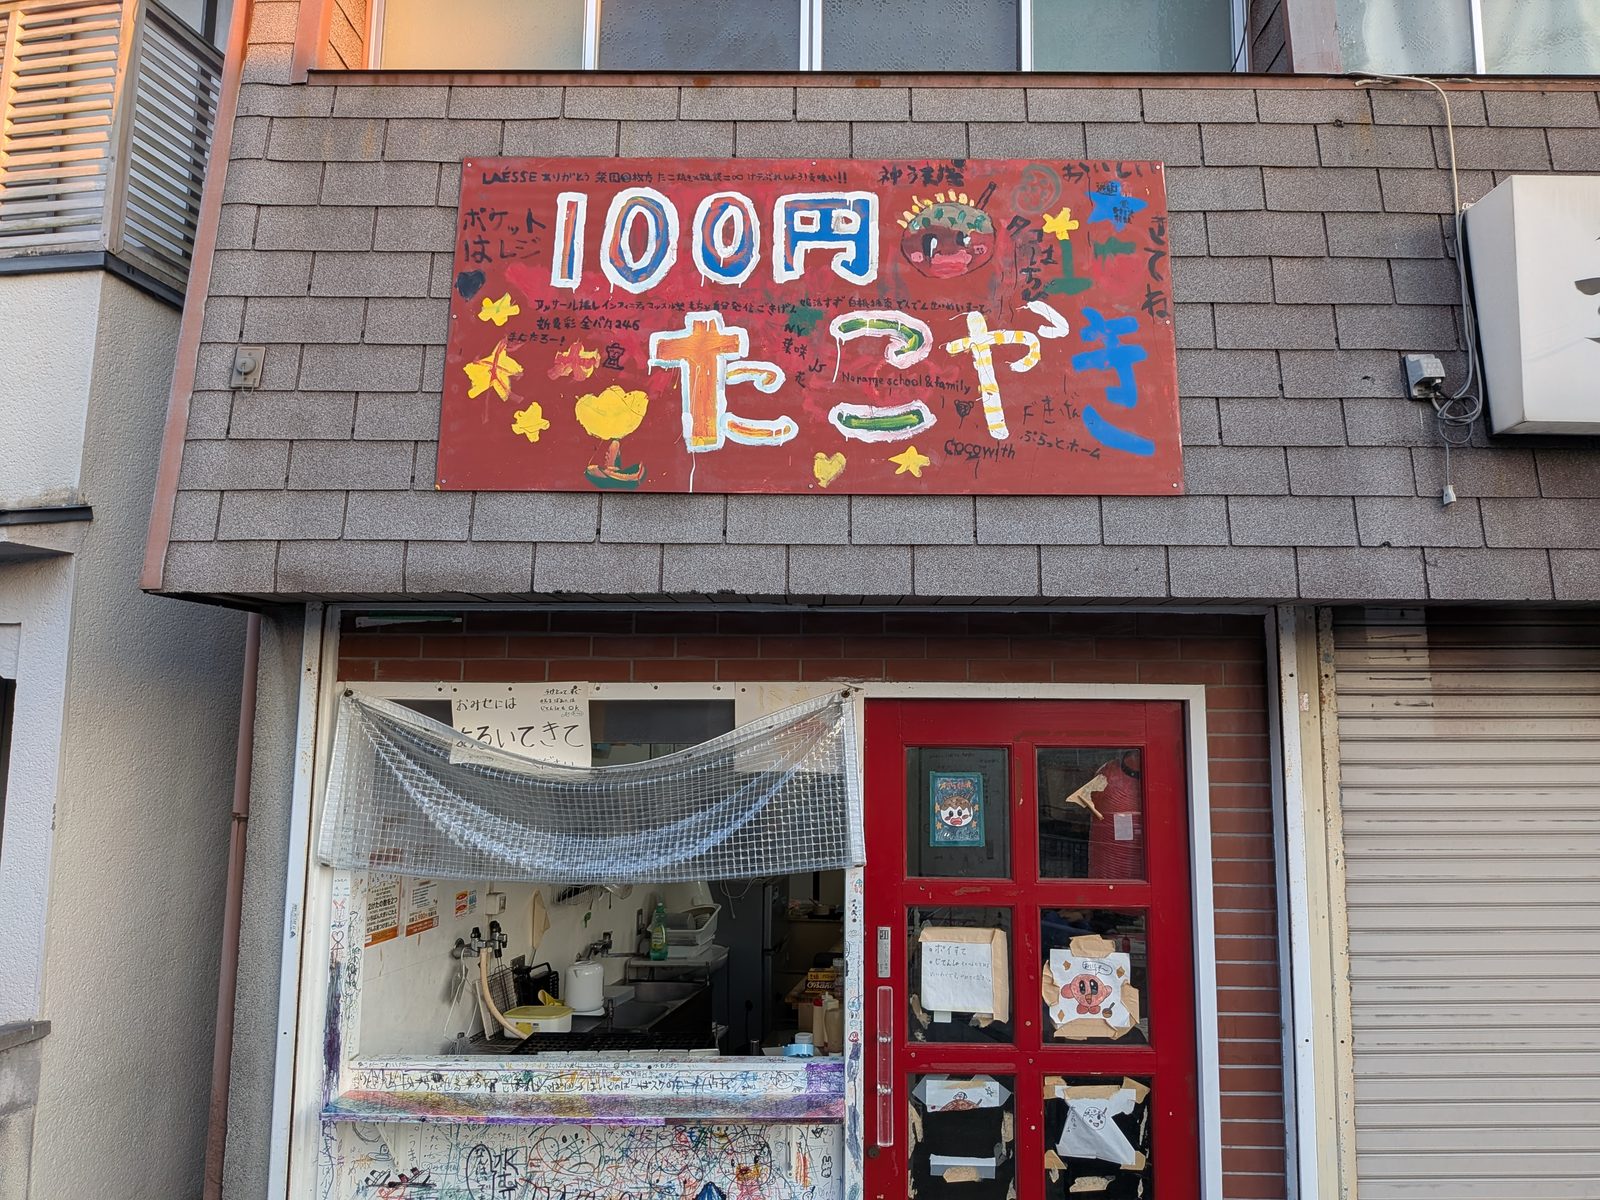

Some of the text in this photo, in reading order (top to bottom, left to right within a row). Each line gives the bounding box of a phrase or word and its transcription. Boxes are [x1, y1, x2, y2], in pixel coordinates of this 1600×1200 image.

[463, 207, 547, 235] ポケット
[551, 187, 879, 293] 100円
[648, 301, 1156, 457] たこやき
[456, 697, 517, 711] おみせには
